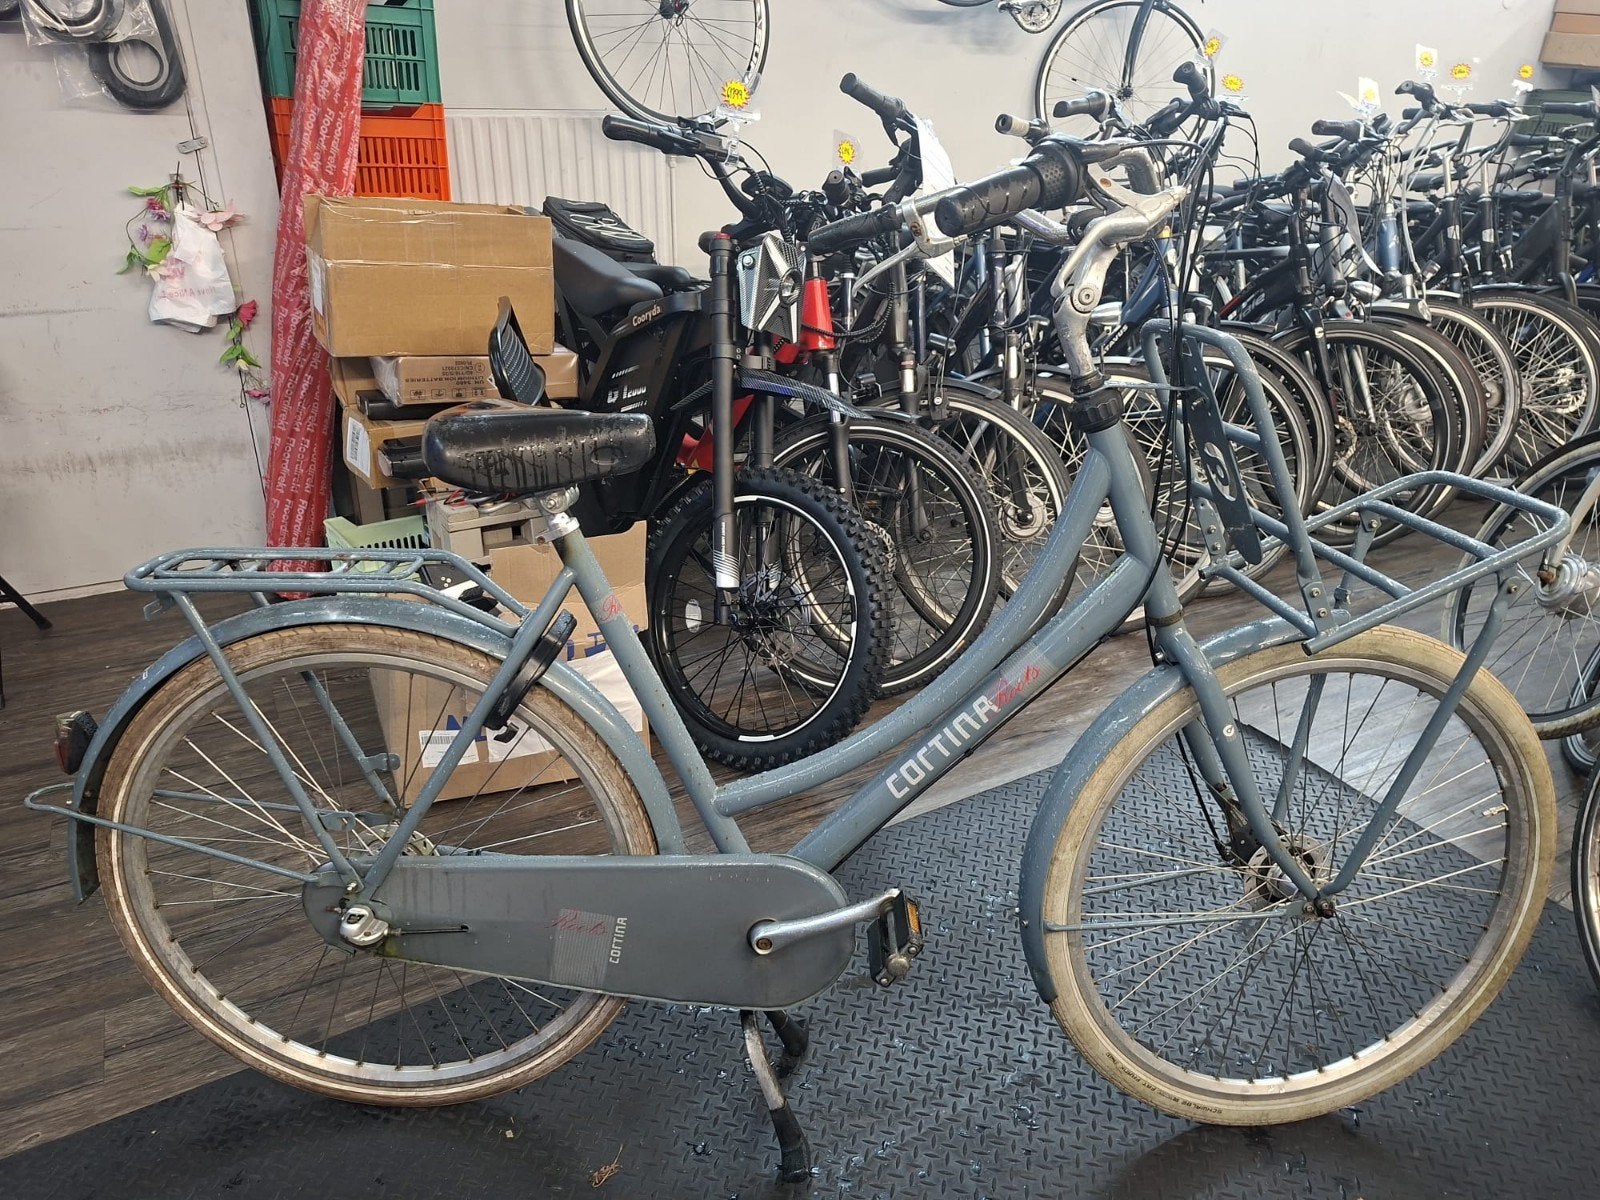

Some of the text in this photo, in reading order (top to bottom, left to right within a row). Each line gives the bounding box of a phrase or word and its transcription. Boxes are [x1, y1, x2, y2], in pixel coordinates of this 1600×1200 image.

[632, 304, 661, 327] Cooryda
[885, 695, 1001, 799] CORTINA
[609, 917, 628, 964] CORTINA
